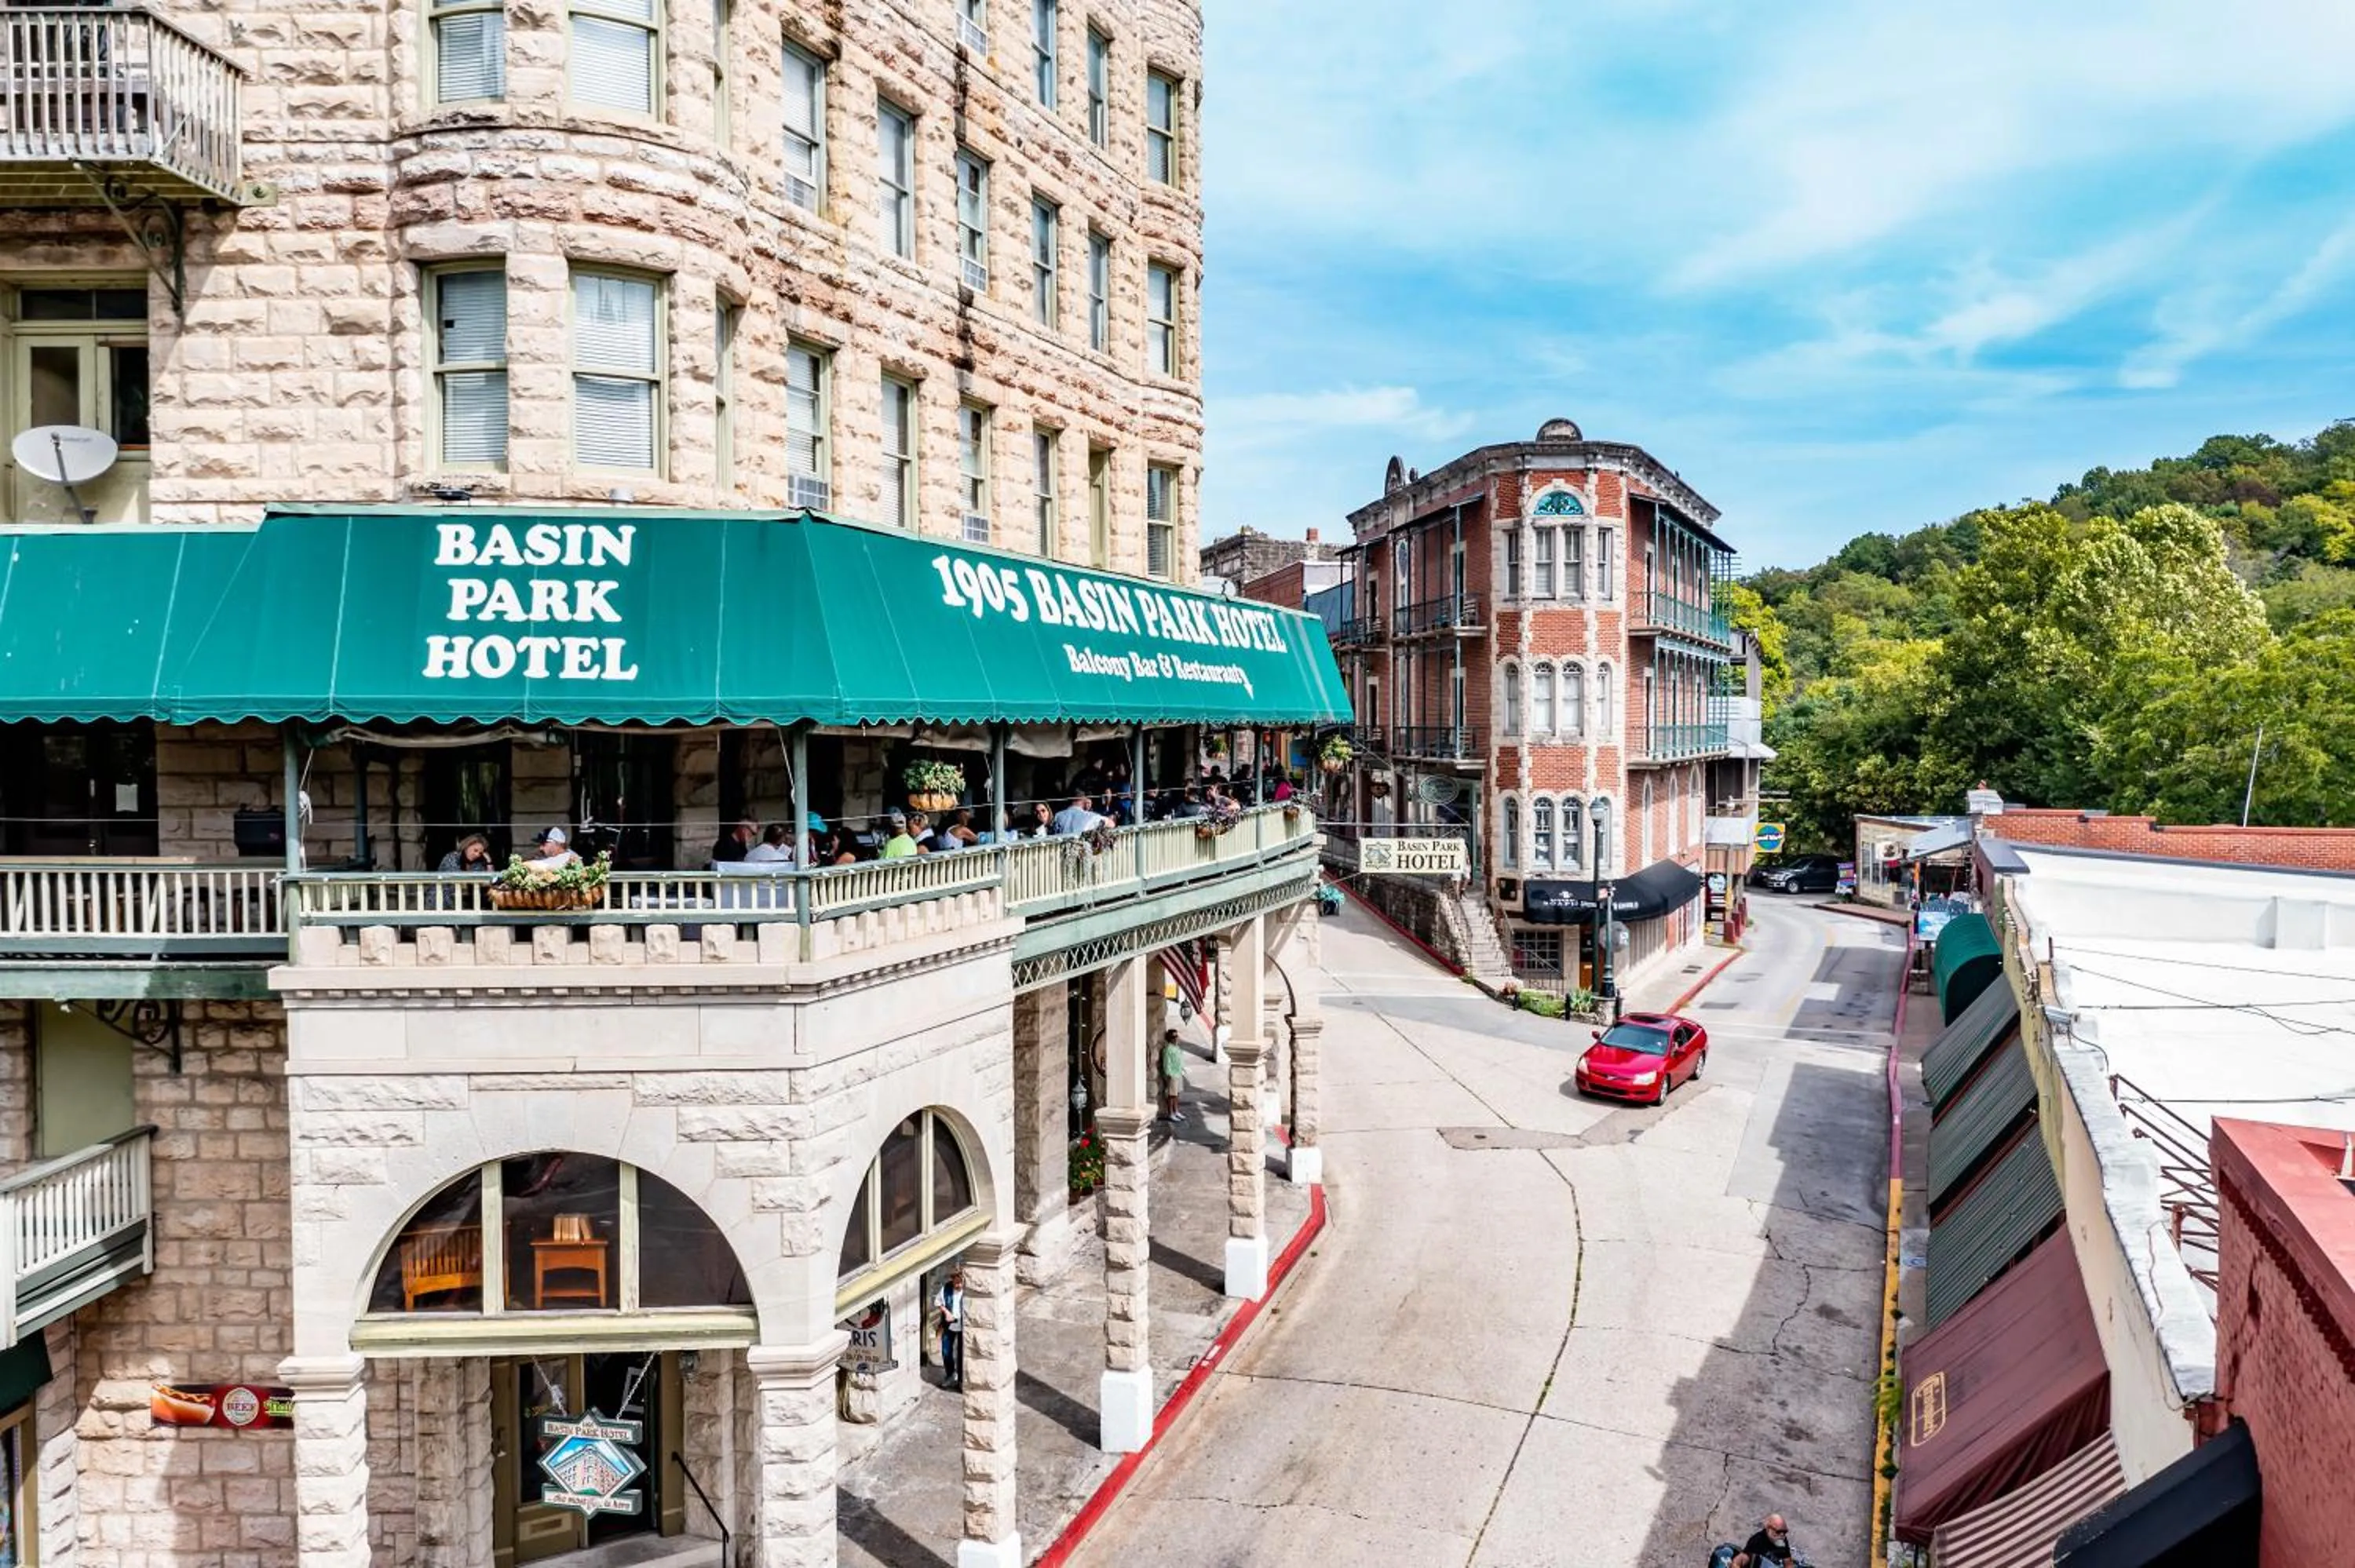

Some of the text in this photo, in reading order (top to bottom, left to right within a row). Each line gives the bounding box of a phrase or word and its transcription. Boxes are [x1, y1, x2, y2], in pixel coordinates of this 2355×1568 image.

[434, 523, 637, 566] BASIN
[446, 578, 623, 622] PARK
[932, 556, 1288, 654] 1905 BASIN PARK HOTEL
[422, 634, 638, 680] HOTEL
[1063, 643, 1245, 684] Balcony Bar & Restaurant
[1397, 853, 1461, 870] HOTEL
